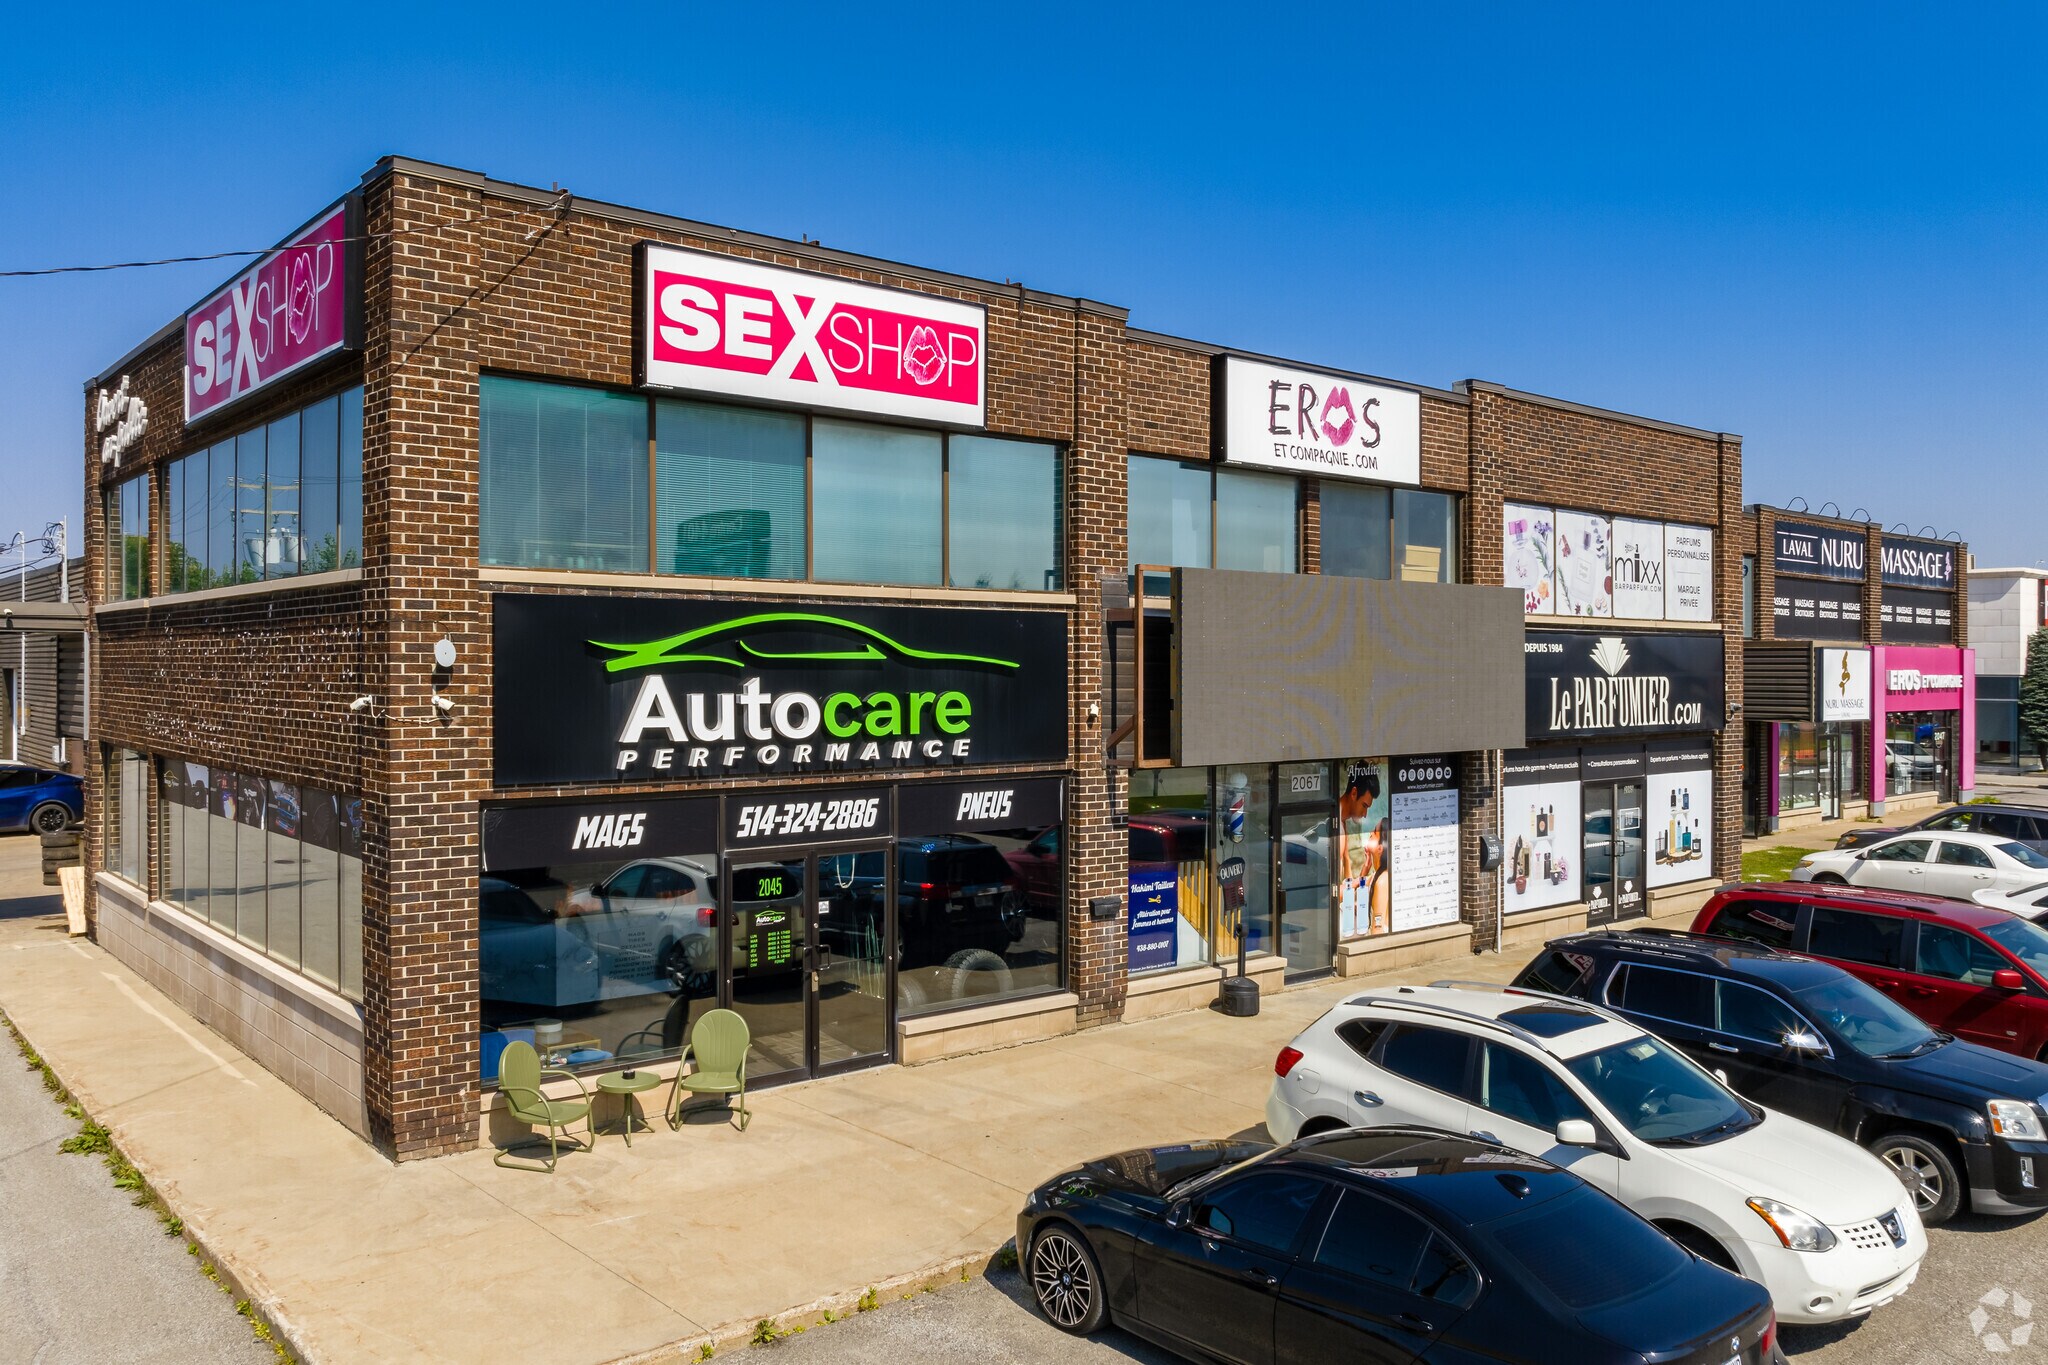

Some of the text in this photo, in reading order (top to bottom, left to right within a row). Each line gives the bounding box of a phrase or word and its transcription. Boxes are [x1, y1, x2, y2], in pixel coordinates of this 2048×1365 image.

[1268, 379, 1381, 449] EROS
[1274, 442, 1288, 458] ET
[1676, 536, 1701, 547] PARFUMS
[1614, 551, 1662, 586] mixx
[1783, 538, 1944, 579] LAVAL NURU MASSAGE
[1614, 582, 1662, 592] BARPARFUM.COM
[1678, 585, 1700, 594] MARQUE
[1794, 598, 1814, 608] MASSAGE
[1819, 600, 1838, 609] MASSAGE
[1525, 643, 1563, 652] DEPUIS 1984
[1888, 670, 1920, 690] EROS
[618, 673, 972, 744] Autocare
[1549, 677, 1571, 730] Le
[615, 738, 972, 772] PERFORMANCE
[1347, 762, 1380, 783] Afrodite
[1292, 776, 1319, 790] 2067
[956, 790, 1015, 822] PNEUS
[736, 798, 880, 839] 514-324-2886
[572, 813, 648, 850] MAGS
[1220, 863, 1243, 880] OUVERT
[759, 877, 782, 896] 2045
